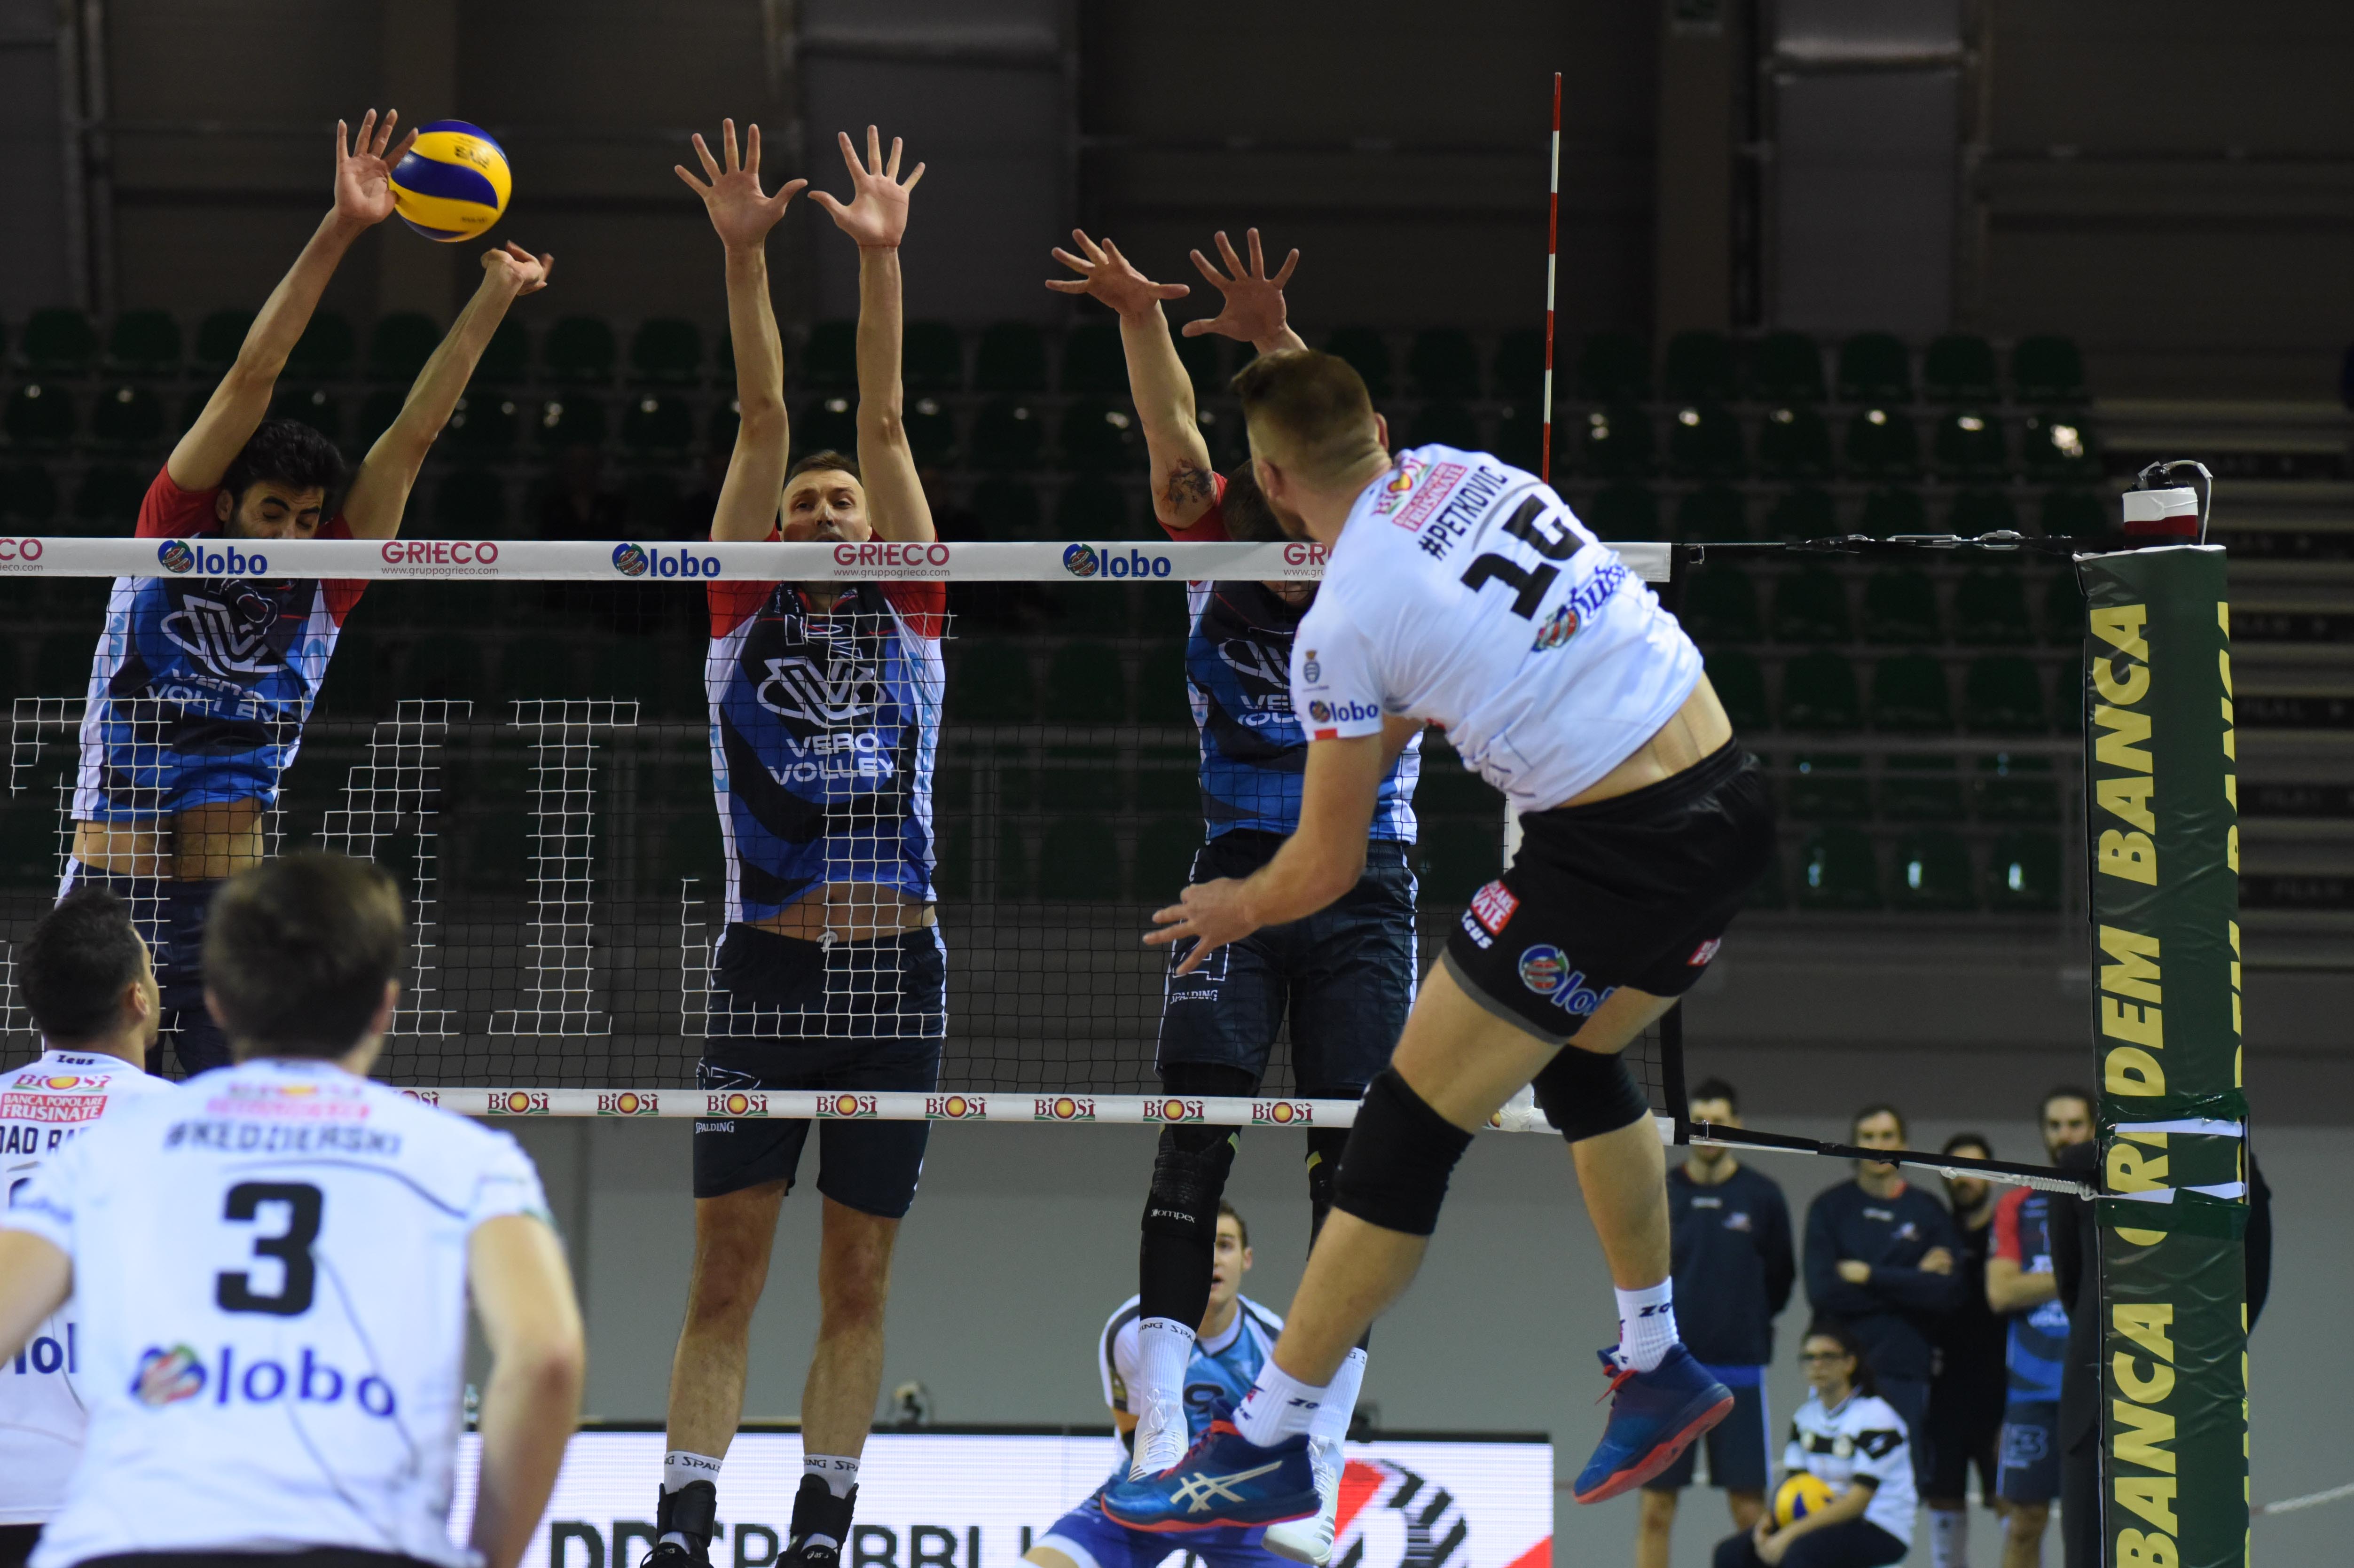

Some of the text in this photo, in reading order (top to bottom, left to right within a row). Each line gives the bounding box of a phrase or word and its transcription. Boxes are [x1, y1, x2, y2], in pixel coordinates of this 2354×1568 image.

[1418, 465, 1508, 561] #PETKOVIC
[382, 541, 498, 564] GRIECO
[834, 543, 949, 566] GRIECO
[382, 566, 498, 577] www.gruppogrieco.com
[833, 567, 950, 578] www.gruppogrieco.com
[785, 733, 879, 758] VERO
[768, 757, 894, 785] VOLLEY
[1170, 989, 1218, 1005] SPALDING
[56, 1055, 95, 1065] Zeus
[2090, 604, 2179, 1568] BANCA RDEM BANCA
[4, 1094, 103, 1106] BANCA POPOLARE
[2, 1105, 100, 1121] FRUSINATE
[695, 1121, 734, 1134] SPALDING
[216, 1181, 323, 1317] 3
